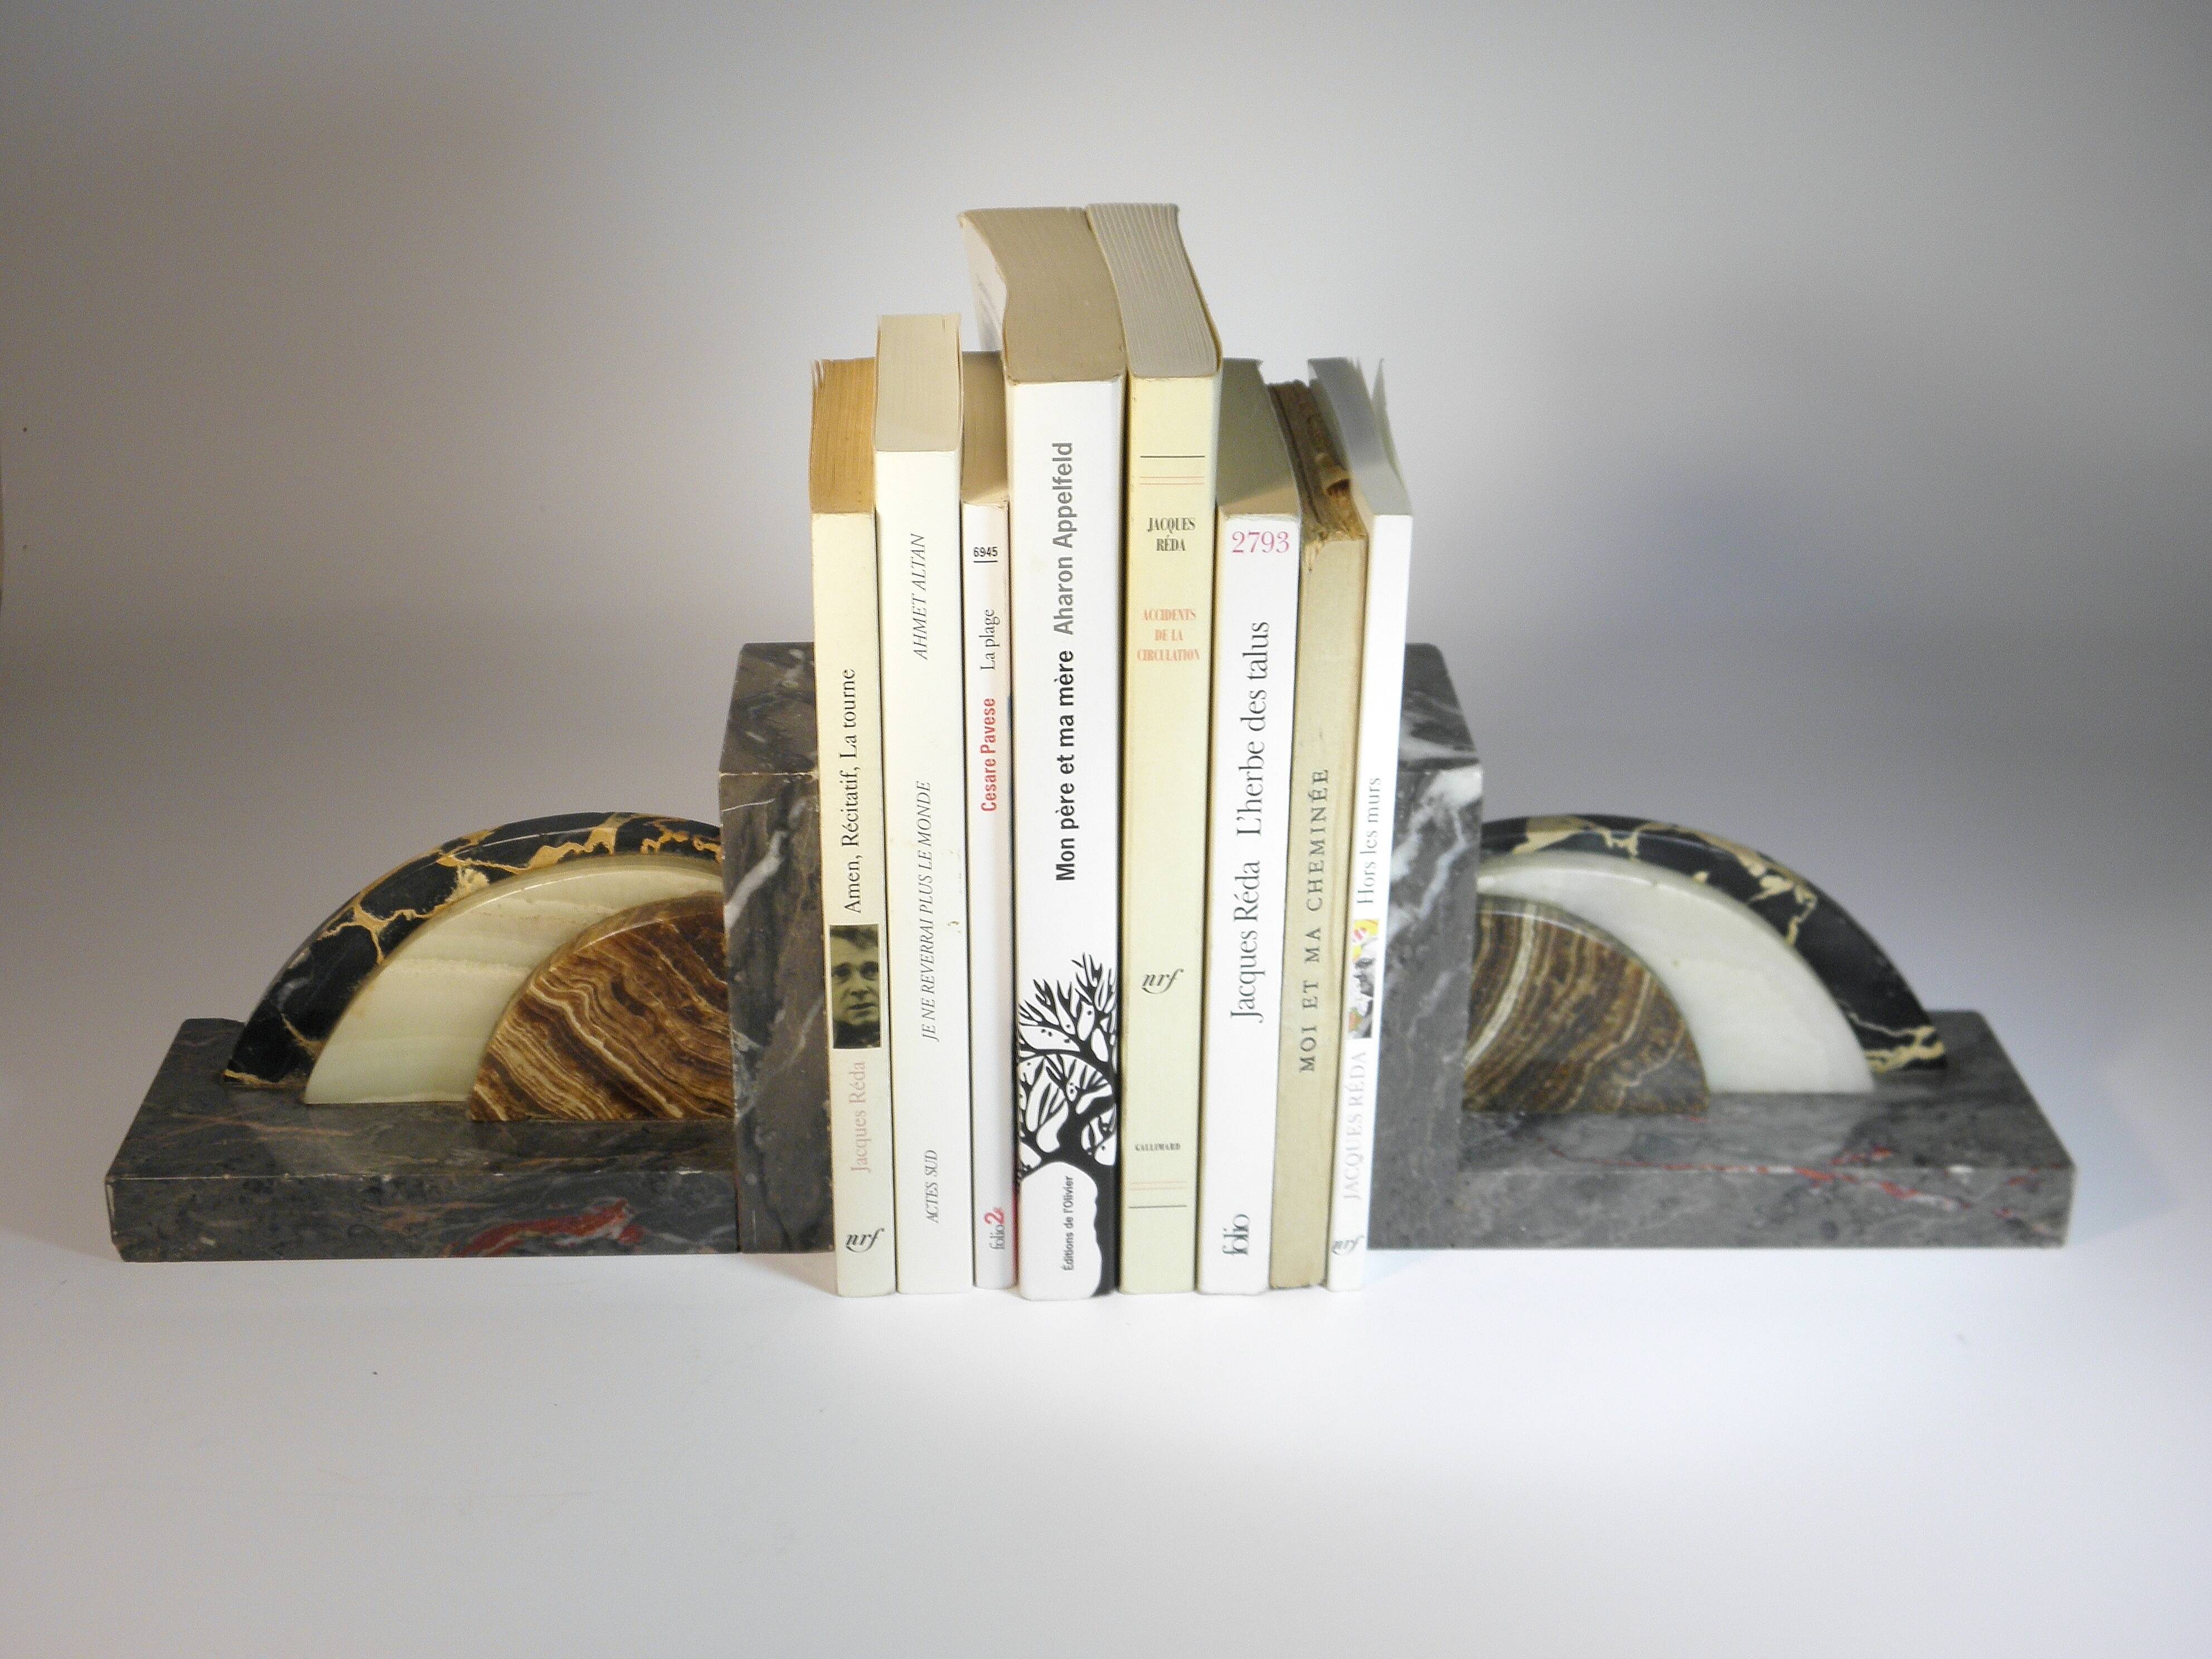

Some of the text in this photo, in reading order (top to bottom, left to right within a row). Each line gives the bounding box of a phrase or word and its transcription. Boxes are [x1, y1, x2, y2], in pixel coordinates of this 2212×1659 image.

[1051, 442, 1078, 636] Aharon Appelfeld
[1147, 517, 1196, 535] JACQUES
[1156, 534, 1186, 552] RÉDA
[1231, 531, 1290, 554] 2793
[973, 546, 998, 557] 6945
[910, 533, 928, 661] AHMET ALTAN
[1143, 608, 1197, 622] ACCIDENTS
[978, 609, 1001, 671] La plage
[1137, 648, 1200, 662] CIRCULATION
[1154, 628, 1183, 642] DE LA
[1242, 622, 1269, 680] talus
[1239, 690, 1267, 732] des
[980, 698, 998, 812] Cesare Pavese
[1054, 650, 1080, 881] Mon père et ma mère
[839, 669, 862, 914] Amen, Récitatif, La tourne
[1356, 778, 1380, 904] Hors les murs
[916, 780, 940, 1042] JE NE REVERRAI PLUS LE MONDE
[1299, 769, 1328, 1073] MOI ET MA CHEMINÉE
[1230, 860, 1265, 1023] Jacques Réda
[1141, 968, 1184, 995] nrf
[848, 1061, 872, 1173] Jacques Réda
[1343, 1051, 1366, 1200] JACQUES RÉDA
[1134, 1142, 1181, 1152] GALLIMARD
[924, 1149, 939, 1224] ACTES SUD
[845, 1228, 885, 1253] nrf
[989, 1225, 1005, 1249] folio
[1063, 1216, 1074, 1229] de
[1222, 1214, 1249, 1255] folio
[1061, 1231, 1074, 1271] Éditions
